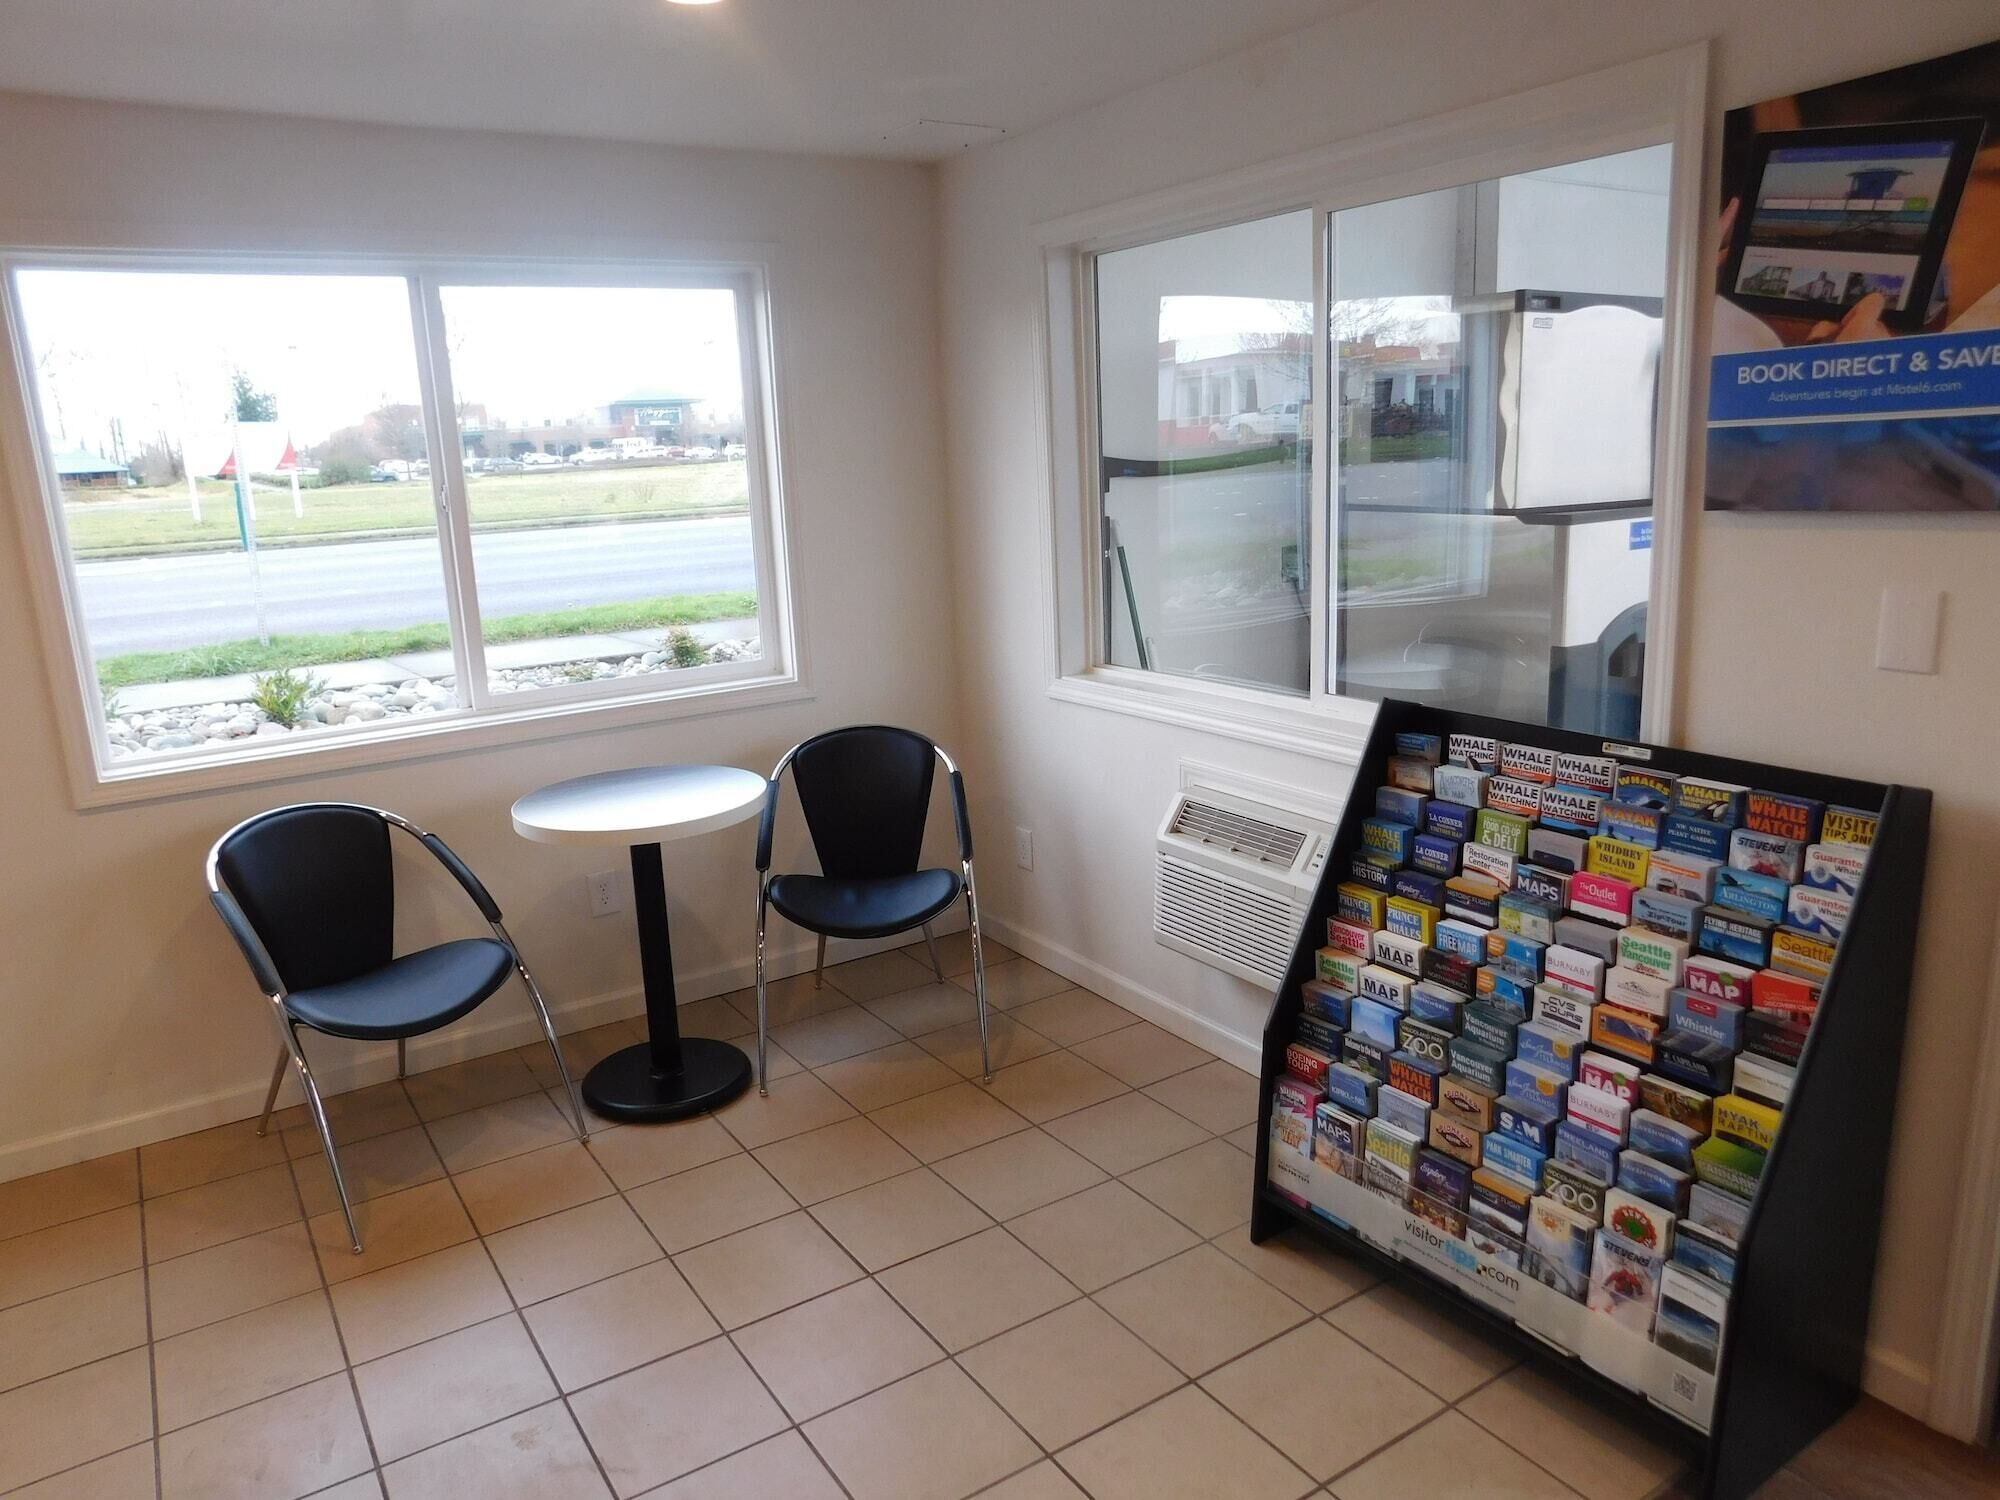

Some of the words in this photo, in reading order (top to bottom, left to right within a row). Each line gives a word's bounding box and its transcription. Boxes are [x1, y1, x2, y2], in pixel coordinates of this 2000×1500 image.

[1737, 362, 1803, 384] BOOK
[1812, 354, 1902, 379] DIRECT
[1908, 352, 1928, 372] &
[1938, 345, 2000, 370] SAVE
[1768, 390, 1831, 402] Adventures
[1834, 388, 1867, 400] begin
[1871, 386, 1882, 397] at
[1886, 380, 1962, 396] Motel6.com
[1450, 737, 1494, 751] WHALE
[1450, 748, 1494, 761] WATCHING
[1502, 758, 1551, 775] WATCHING
[1504, 746, 1552, 766] WHALE
[1557, 757, 1610, 777] WHALE
[1556, 770, 1609, 786] WATCHING
[1618, 775, 1670, 796] WHALES
[1489, 792, 1538, 809] WATCHING
[1491, 781, 1538, 800] WHALE
[1543, 791, 1596, 811] WHALE
[1681, 784, 1730, 801] WHALE
[1429, 813, 1439, 822] LA
[1440, 815, 1463, 829] CONNER
[1542, 804, 1595, 821] WATCHING
[1602, 806, 1657, 827] KAYAK
[1749, 800, 1808, 825] WHALE
[1363, 824, 1400, 841] WHALE
[1482, 819, 1499, 833] FOOD
[1746, 815, 1807, 841] WATCH
[1363, 836, 1400, 853] WATCH
[1482, 830, 1491, 845] &
[1493, 833, 1518, 852] DELI
[1595, 840, 1643, 861] WHIDBEY
[1737, 836, 1785, 854] STEVENS
[1416, 845, 1424, 854] LA
[1425, 847, 1449, 862] CONNER
[1468, 858, 1491, 870] Center
[1469, 848, 1509, 868] Restoration
[1599, 853, 1635, 870] ISLAND
[1352, 865, 1388, 885] HISTORY
[1517, 876, 1559, 900] MAPS
[1589, 884, 1617, 902] Outlet
[1339, 894, 1371, 912] PRINCE
[1719, 887, 1777, 911] ARLINGTON
[1387, 909, 1421, 924] PRINCE
[1329, 920, 1366, 941] Vancouver
[1387, 921, 1422, 941] WHALES
[1704, 916, 1725, 931] FLYING
[1728, 921, 1763, 939] HERITAGE
[1330, 931, 1366, 951] Seattle
[1438, 933, 1457, 950] FREE
[1457, 940, 1478, 955] MAP
[1621, 935, 1672, 961] Seattle
[1780, 935, 1833, 964] Seattle
[1378, 944, 1414, 965] MAP
[1621, 947, 1671, 972] Vancouver
[1547, 957, 1591, 977] BURNABY
[1364, 978, 1399, 999] MAP
[1689, 974, 1741, 1000] MAP
[1541, 1002, 1583, 1024] TOURS
[1464, 1011, 1508, 1038] Vancouver
[1464, 1022, 1505, 1046] Aquarium
[1675, 1014, 1725, 1040] Whistler
[1402, 1033, 1444, 1060] ZOO
[1287, 1048, 1318, 1069] BOEING
[1287, 1057, 1310, 1073] TOUR
[1451, 1049, 1493, 1073] Vancouver
[1390, 1060, 1432, 1084] WHALE
[1451, 1060, 1491, 1082] Aquarium
[1390, 1073, 1432, 1102] WATCH
[1584, 1072, 1632, 1099] MAP
[1570, 1096, 1617, 1120] BURNABY
[1317, 1116, 1351, 1143] MAPS
[1366, 1128, 1410, 1165] Seattle
[1545, 1174, 1597, 1212] ZOO
[1603, 1240, 1650, 1267] STEVENS
